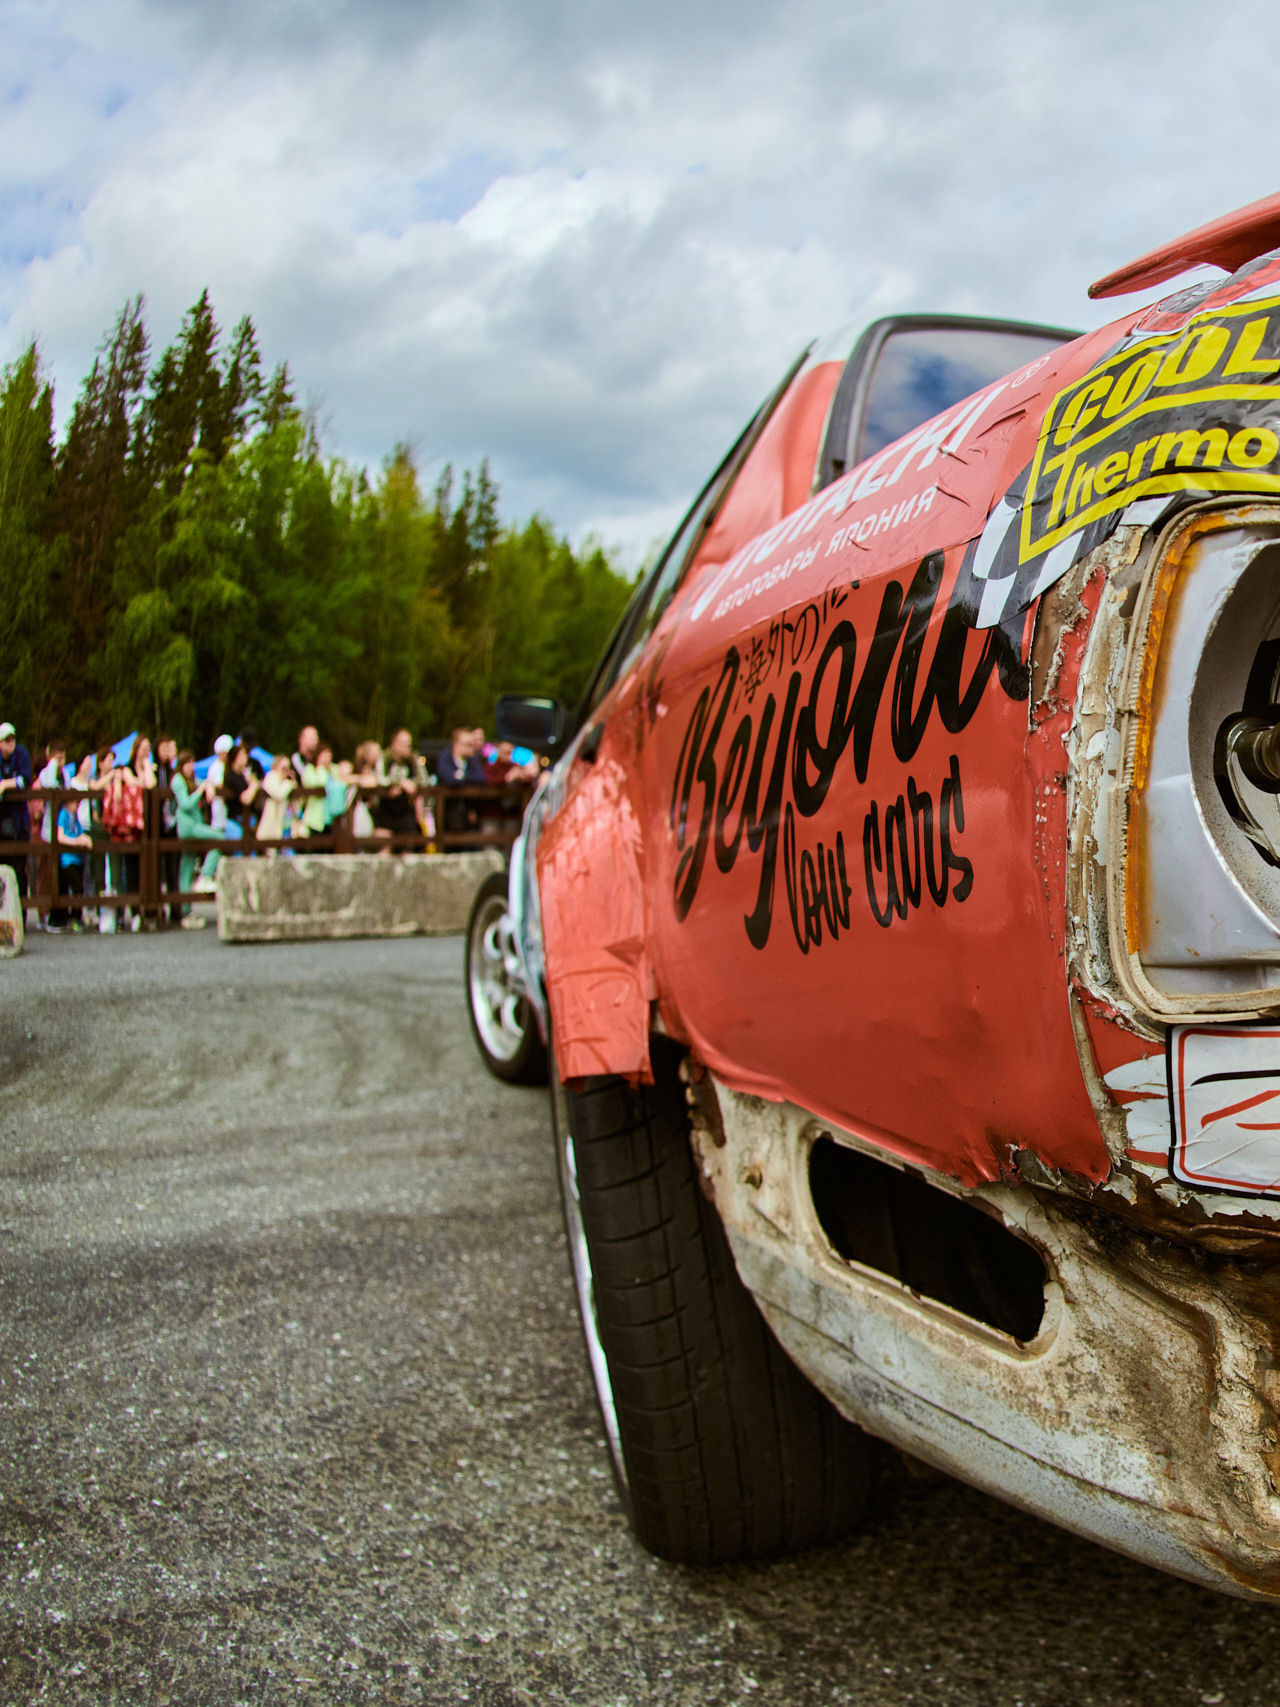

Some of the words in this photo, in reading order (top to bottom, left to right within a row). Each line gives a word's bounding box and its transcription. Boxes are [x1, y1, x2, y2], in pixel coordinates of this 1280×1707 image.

[1042, 427, 1279, 529] Thermo
[711, 541, 821, 622] АВТОТОВАРЫ
[825, 485, 938, 557] ЯПОНИЯ
[784, 801, 852, 955] low
[863, 755, 974, 929] cars
